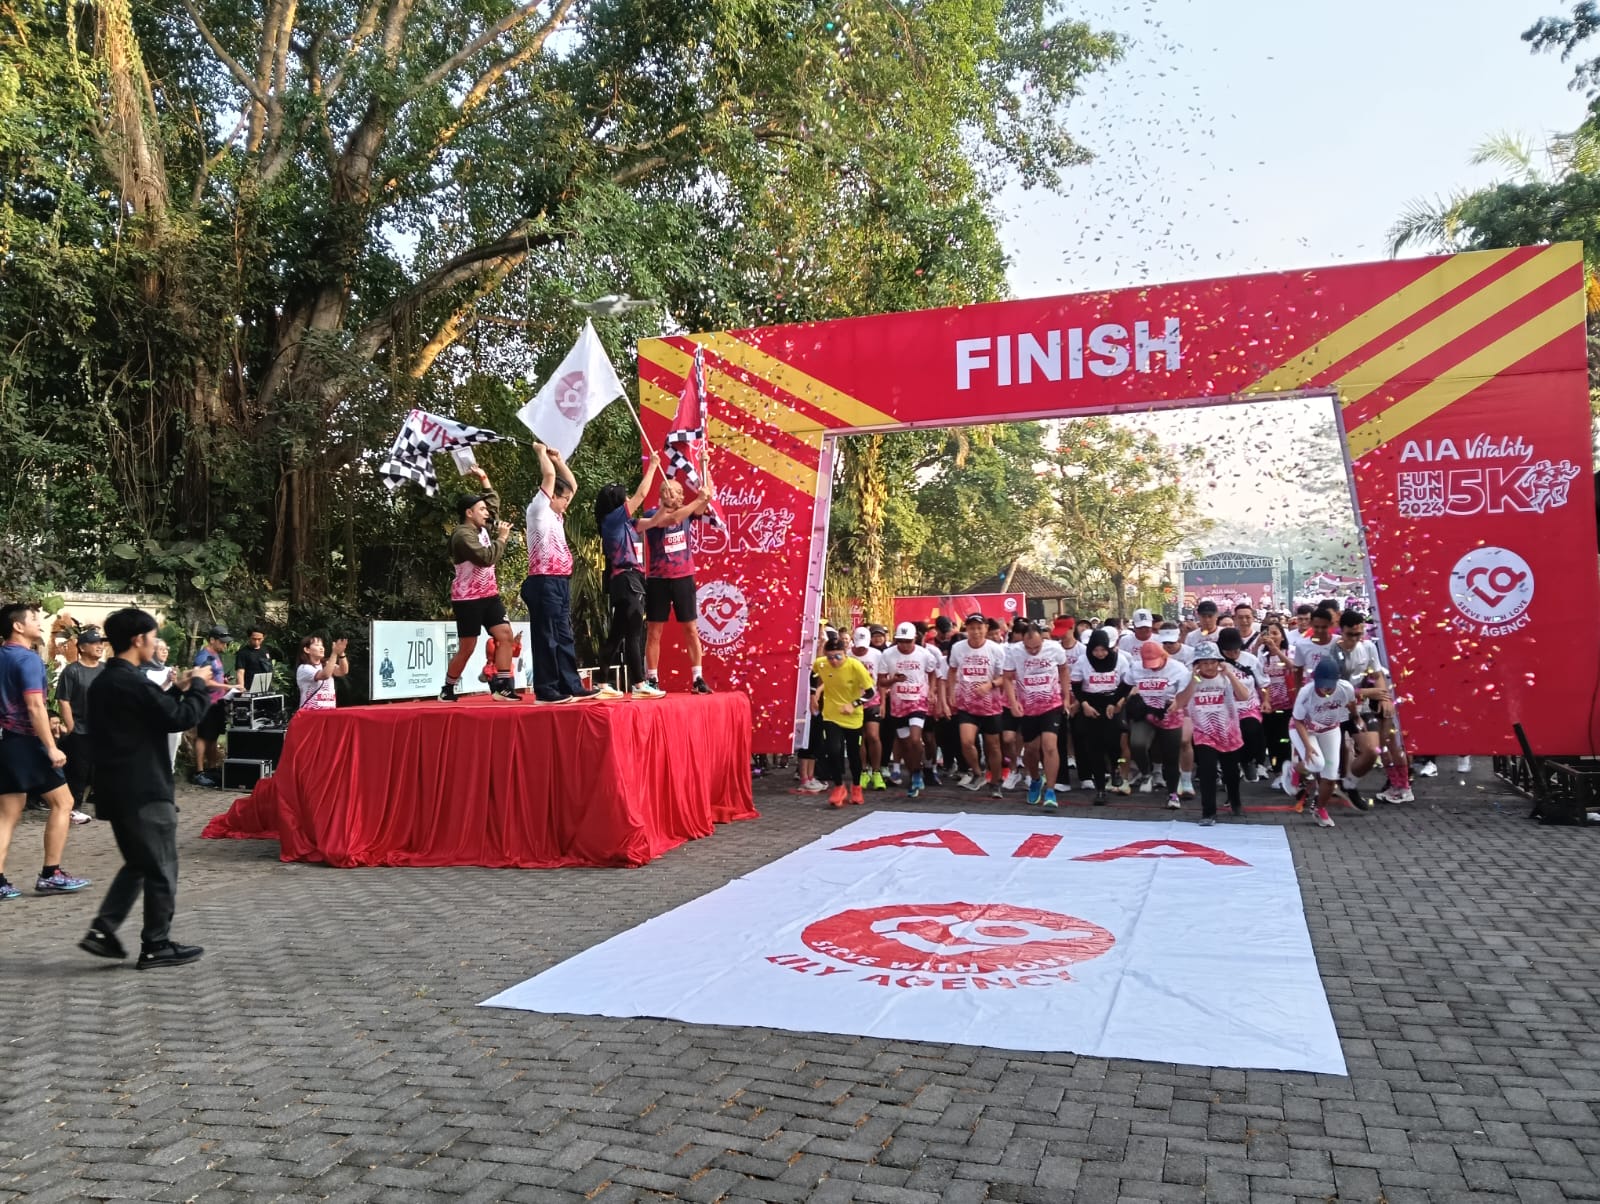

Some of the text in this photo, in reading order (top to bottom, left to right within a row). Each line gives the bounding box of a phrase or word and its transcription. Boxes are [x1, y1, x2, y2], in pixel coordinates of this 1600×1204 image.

[956, 318, 1181, 390] FINISH
[1400, 433, 1534, 464] AIA Vitality
[1399, 471, 1444, 488] FUN
[1446, 467, 1536, 515] 5K
[1399, 487, 1444, 501] RUN
[1399, 502, 1444, 516] 2024
[1458, 601, 1480, 619] SERVE
[1509, 599, 1528, 617] LOVE
[1480, 612, 1532, 637] AGENCY
[407, 637, 434, 670] ZIRO
[828, 828, 1254, 867] AIA
[764, 954, 1081, 991] LILY AGENCY
[890, 960, 979, 973] WITH
